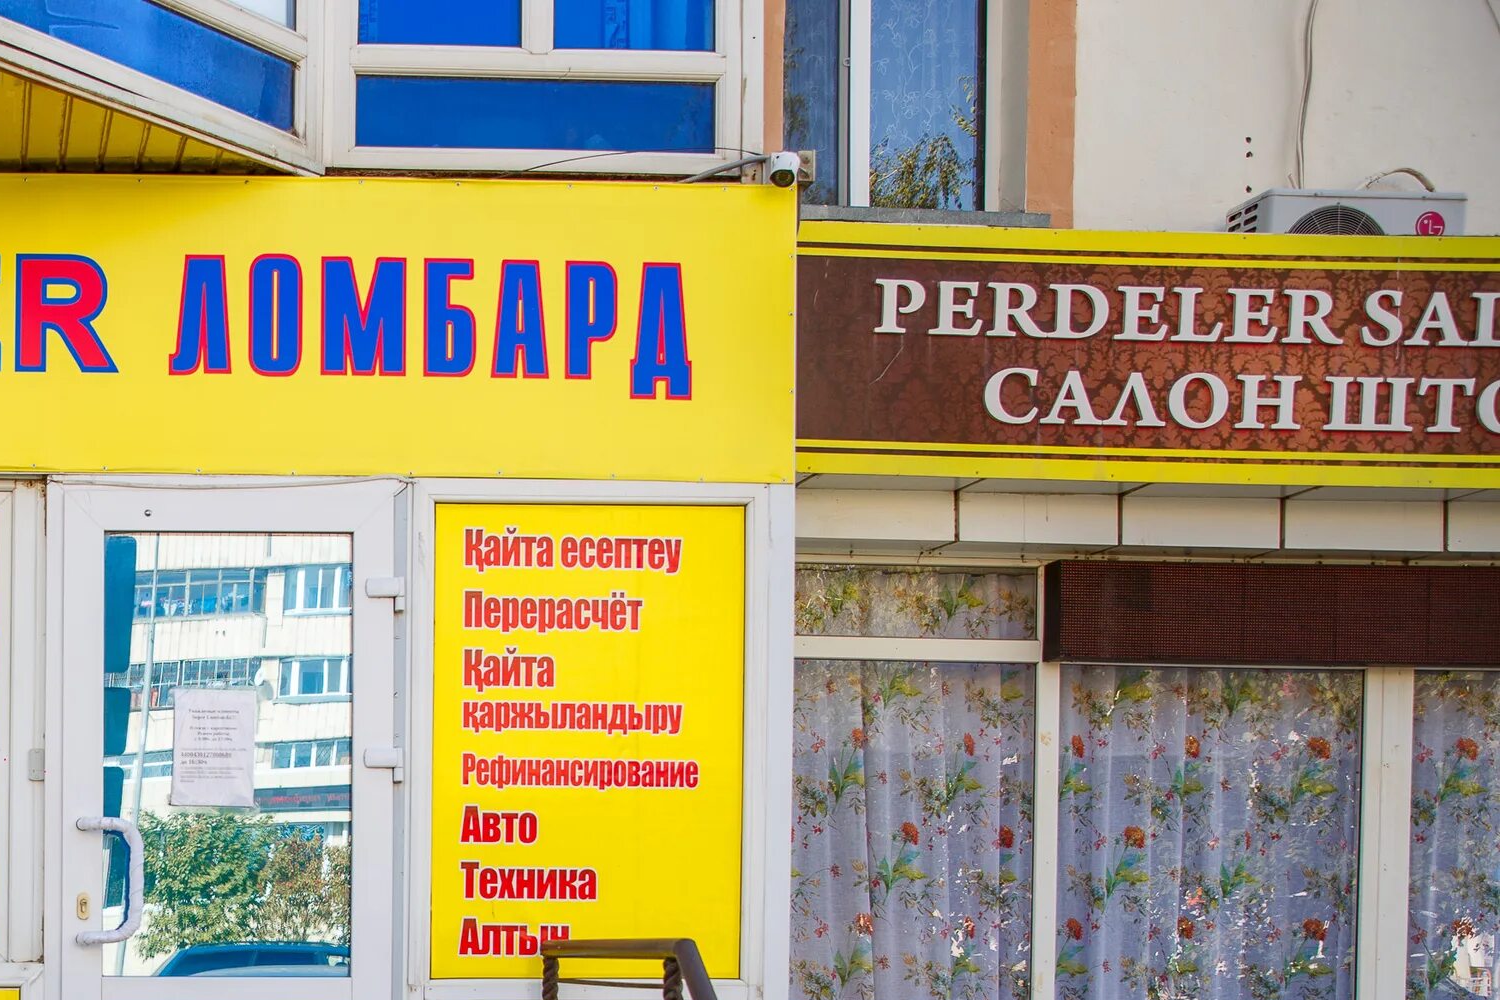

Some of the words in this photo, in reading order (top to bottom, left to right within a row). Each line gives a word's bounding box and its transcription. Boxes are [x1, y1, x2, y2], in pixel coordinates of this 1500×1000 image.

[168, 253, 692, 401] ЛОМБАРД
[873, 278, 1345, 346] PERDELER
[984, 367, 1303, 430] САЛОН
[464, 526, 554, 572] Қайта
[560, 537, 681, 574] есептеу
[463, 591, 643, 633] Перерасчёт
[463, 647, 555, 693] Қайта
[462, 701, 682, 735] қаржыландыру
[462, 753, 699, 790] Рефинансирование
[460, 806, 538, 844] Авто
[460, 861, 597, 900] Техника
